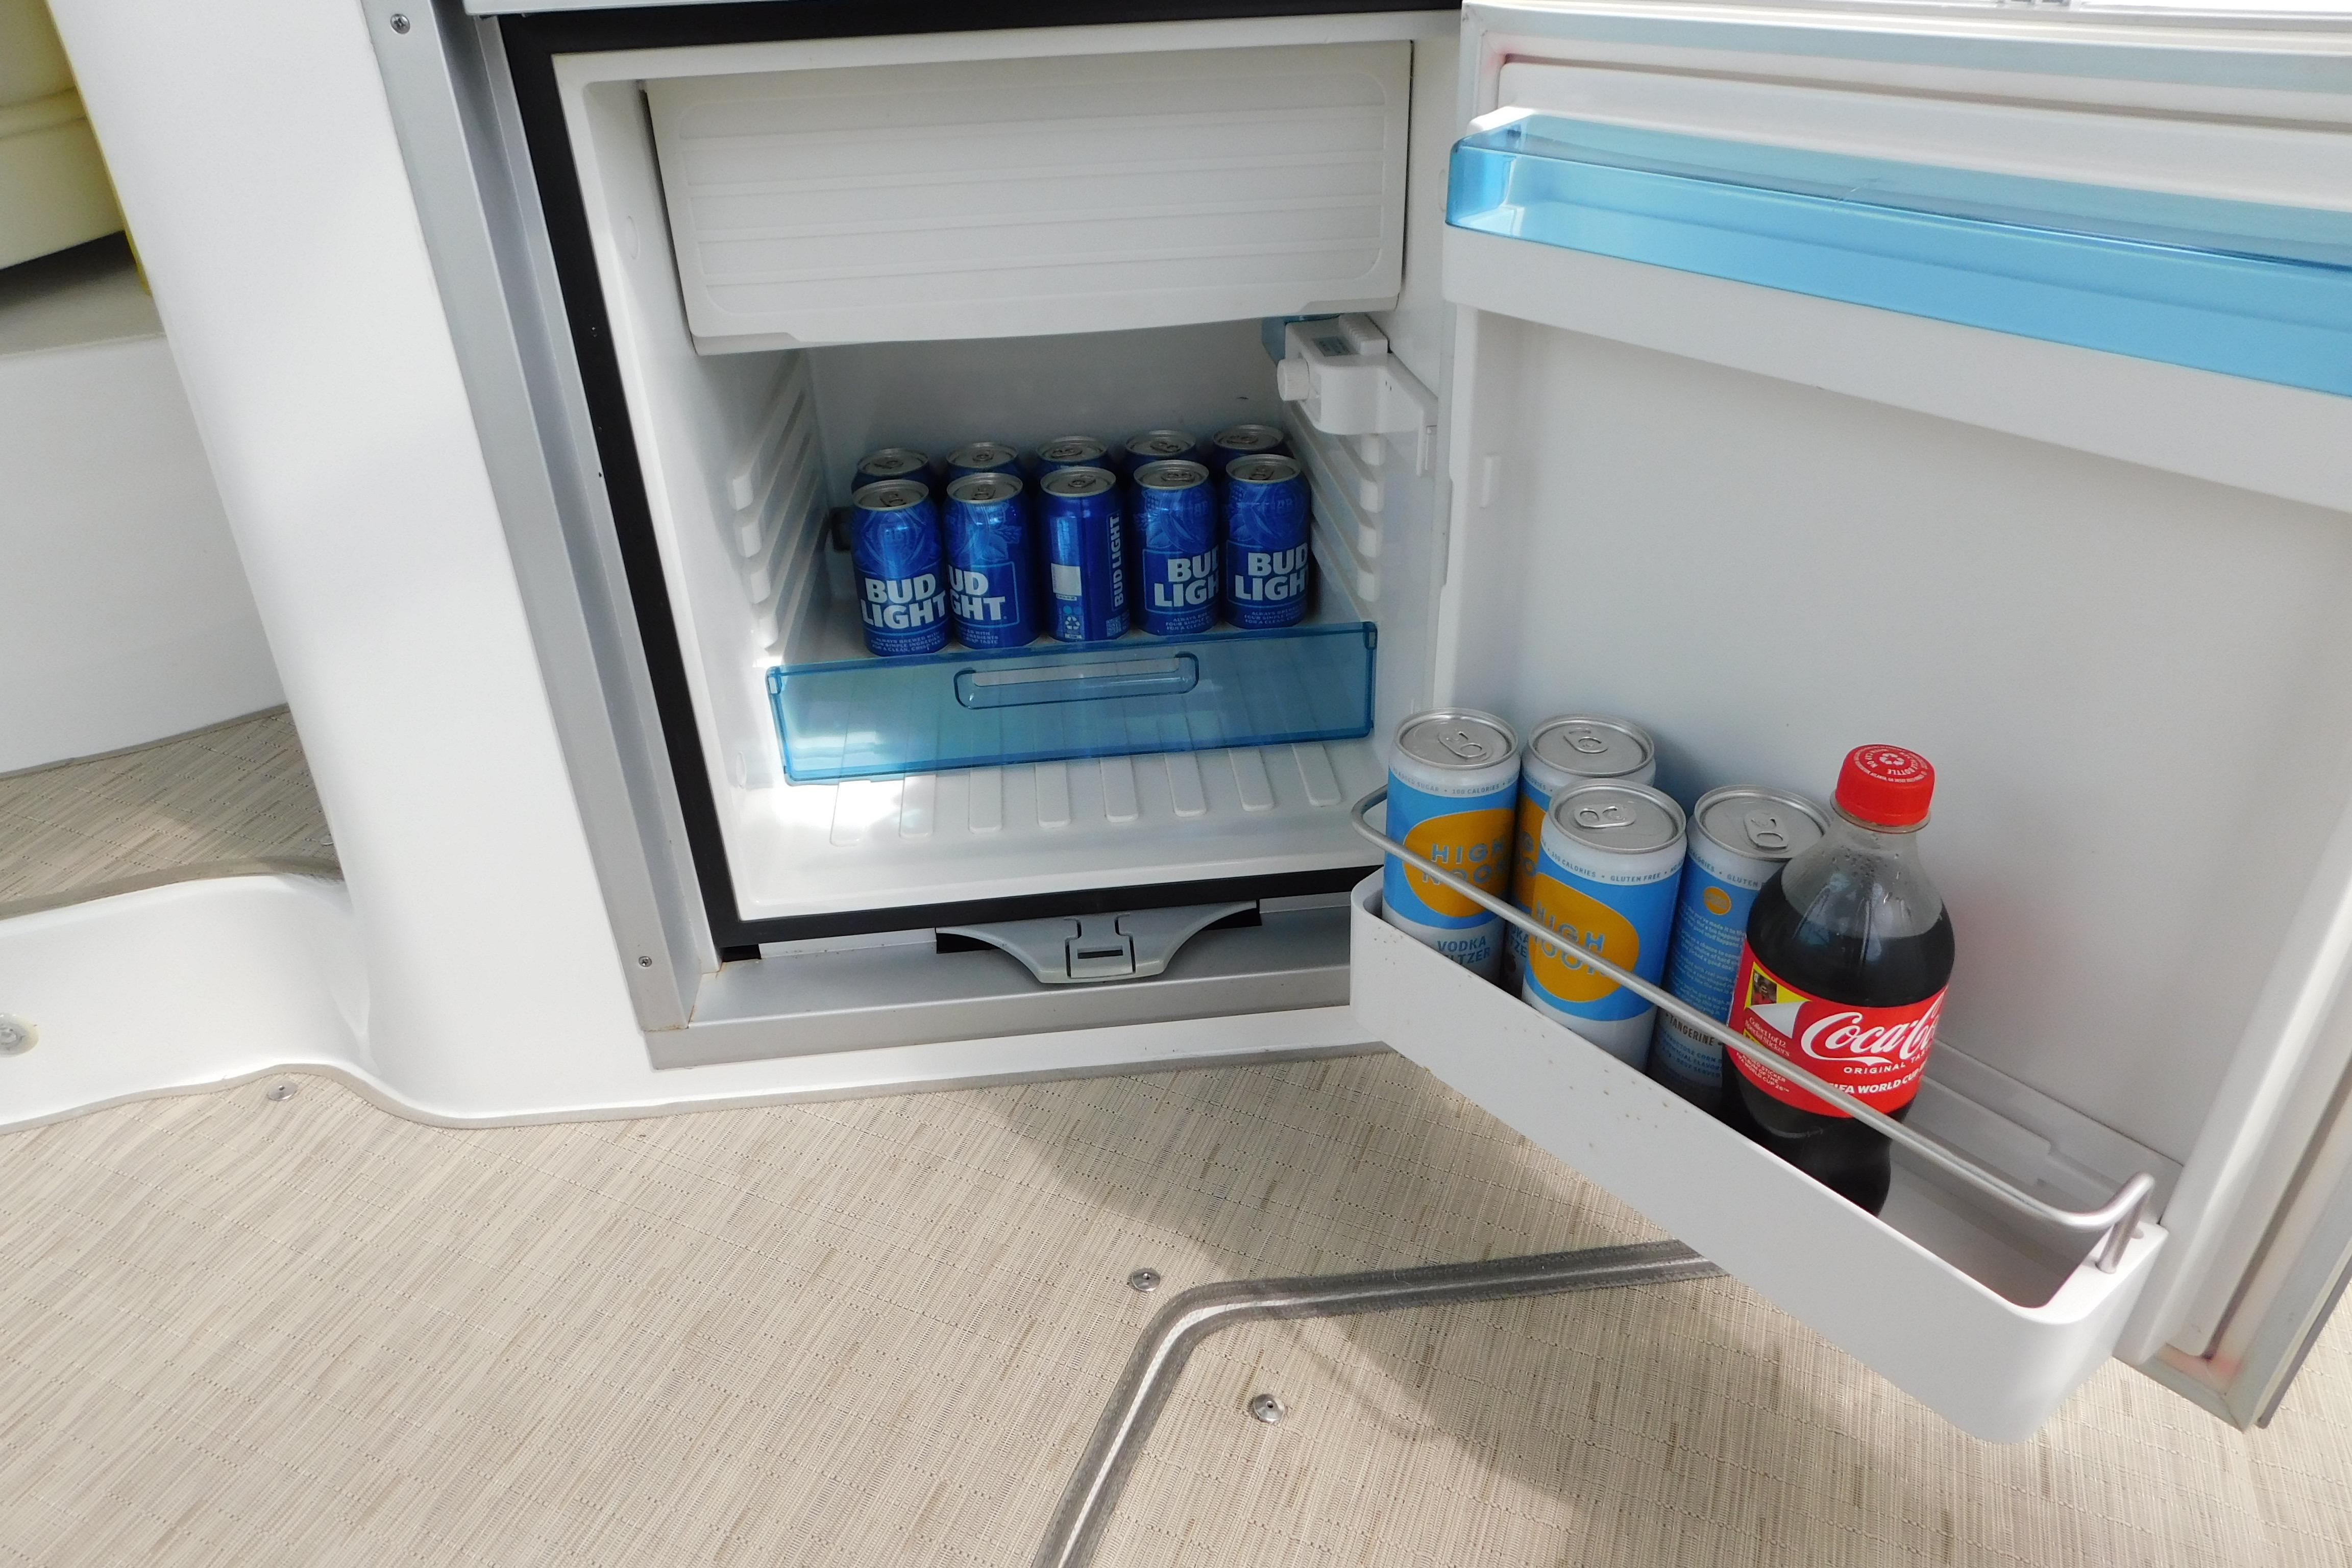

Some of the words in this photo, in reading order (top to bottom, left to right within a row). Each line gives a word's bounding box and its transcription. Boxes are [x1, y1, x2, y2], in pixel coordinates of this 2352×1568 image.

[1110, 516, 1121, 568] LIGHT
[1248, 543, 1308, 576] BUD
[865, 574, 936, 604] BUD
[948, 565, 989, 595] UD
[1113, 569, 1123, 607] BUD
[1154, 569, 1219, 607] LIGH
[1235, 567, 1307, 601] LIGH
[861, 590, 946, 629] LIGHT
[950, 589, 1006, 620] GHT
[1417, 782, 1440, 792] SUGAR
[1467, 783, 1499, 795] CALORIES
[1431, 839, 1505, 864] HIGH
[1551, 851, 1561, 862] 100
[1562, 859, 1597, 877] CALORIES
[1610, 871, 1642, 883] GLUTEN
[1643, 872, 1661, 881] FREE
[1727, 874, 1758, 887] GLUTEN
[1437, 936, 1486, 953] VODKA
[1670, 1014, 1715, 1046] TANGERINE
[1749, 1017, 1768, 1036] Collect
[1779, 1040, 1786, 1048] 12
[1801, 985, 1949, 1067] Coca-Col
[1763, 1037, 1790, 1057] Stickers
[1844, 1063, 1906, 1074] ORIGINAL
[1911, 1049, 1925, 1063] TAS
[1745, 1062, 1762, 1079] WORLD
[1762, 1076, 1775, 1086] CUP
[1761, 1065, 1786, 1083] STICKER
[1768, 1074, 1779, 1084] THE
[1858, 1078, 1900, 1094] WORLD
